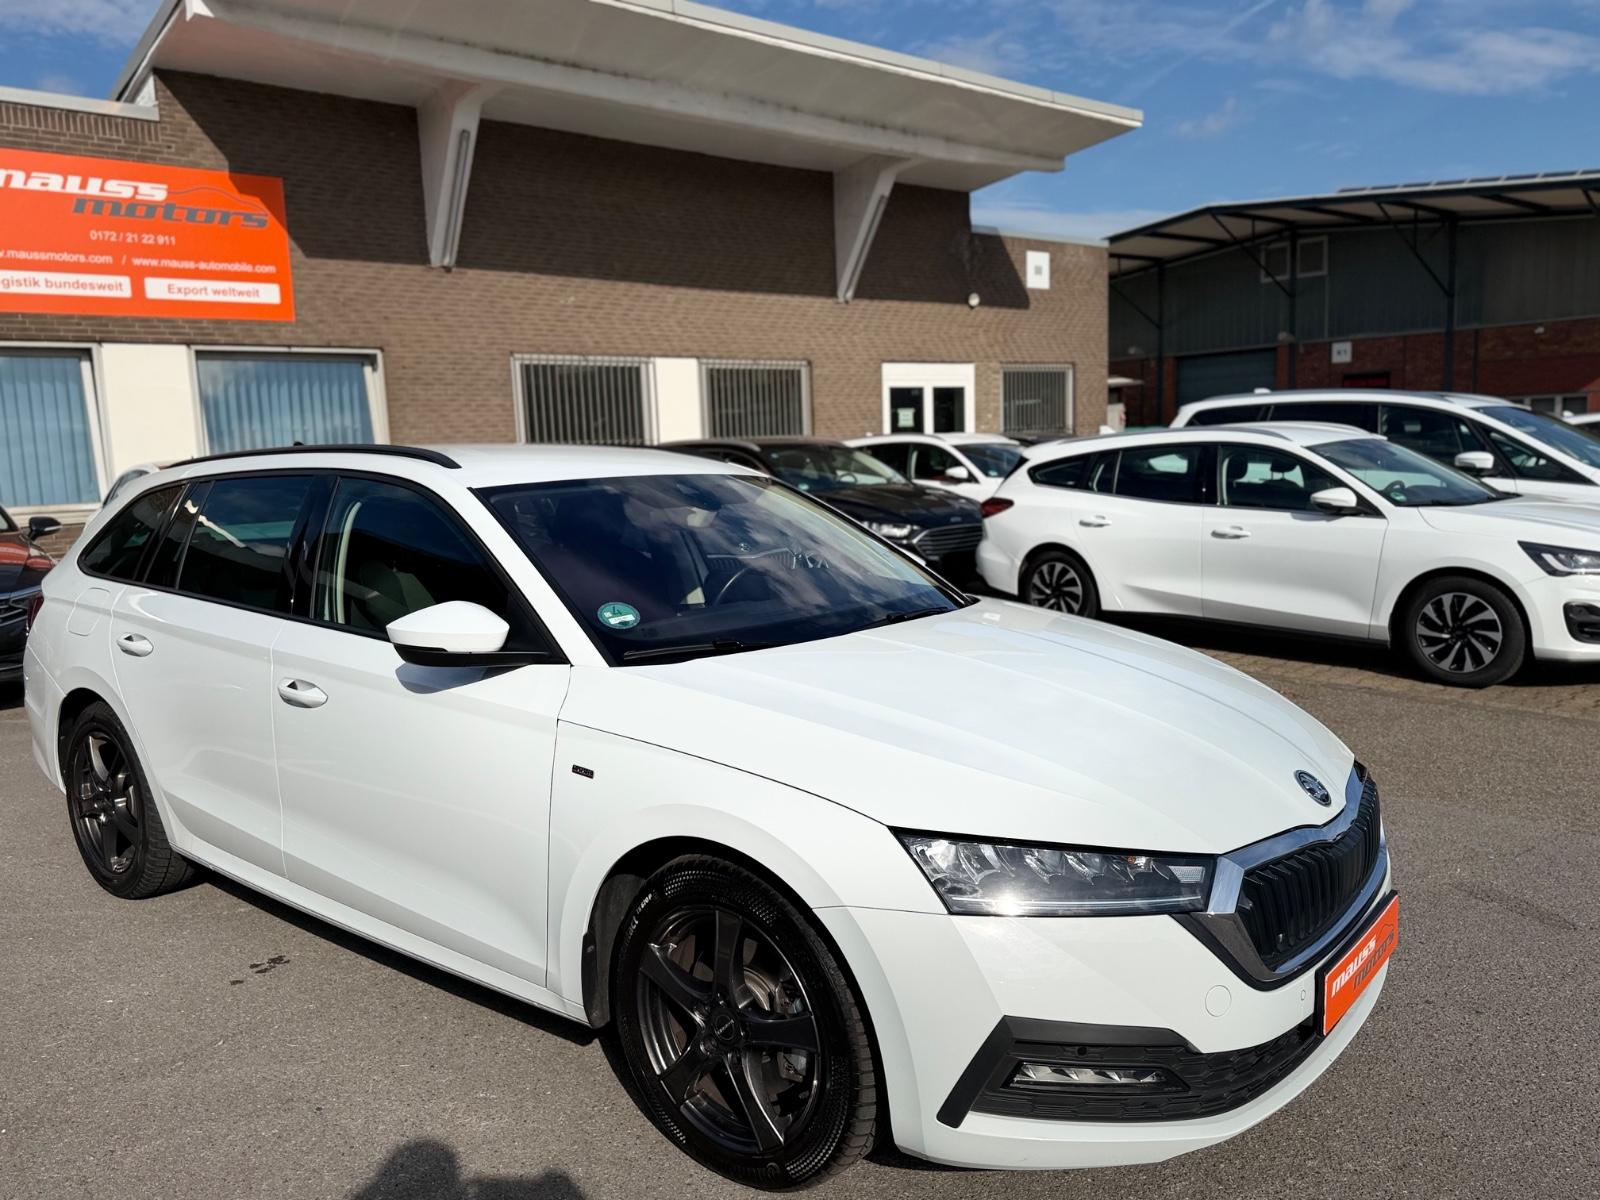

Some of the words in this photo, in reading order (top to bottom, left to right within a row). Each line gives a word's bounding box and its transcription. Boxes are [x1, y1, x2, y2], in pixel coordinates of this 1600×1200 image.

[73, 198, 269, 229] motors
[89, 229, 117, 241] 0172
[125, 232, 139, 243] 21
[141, 233, 155, 244] 22
[156, 234, 176, 246] 911
[44, 278, 124, 292] bundesweit
[167, 283, 209, 297] Export
[212, 286, 260, 298] weltweit
[1331, 934, 1376, 998] mauss
[1353, 927, 1395, 990] motors
